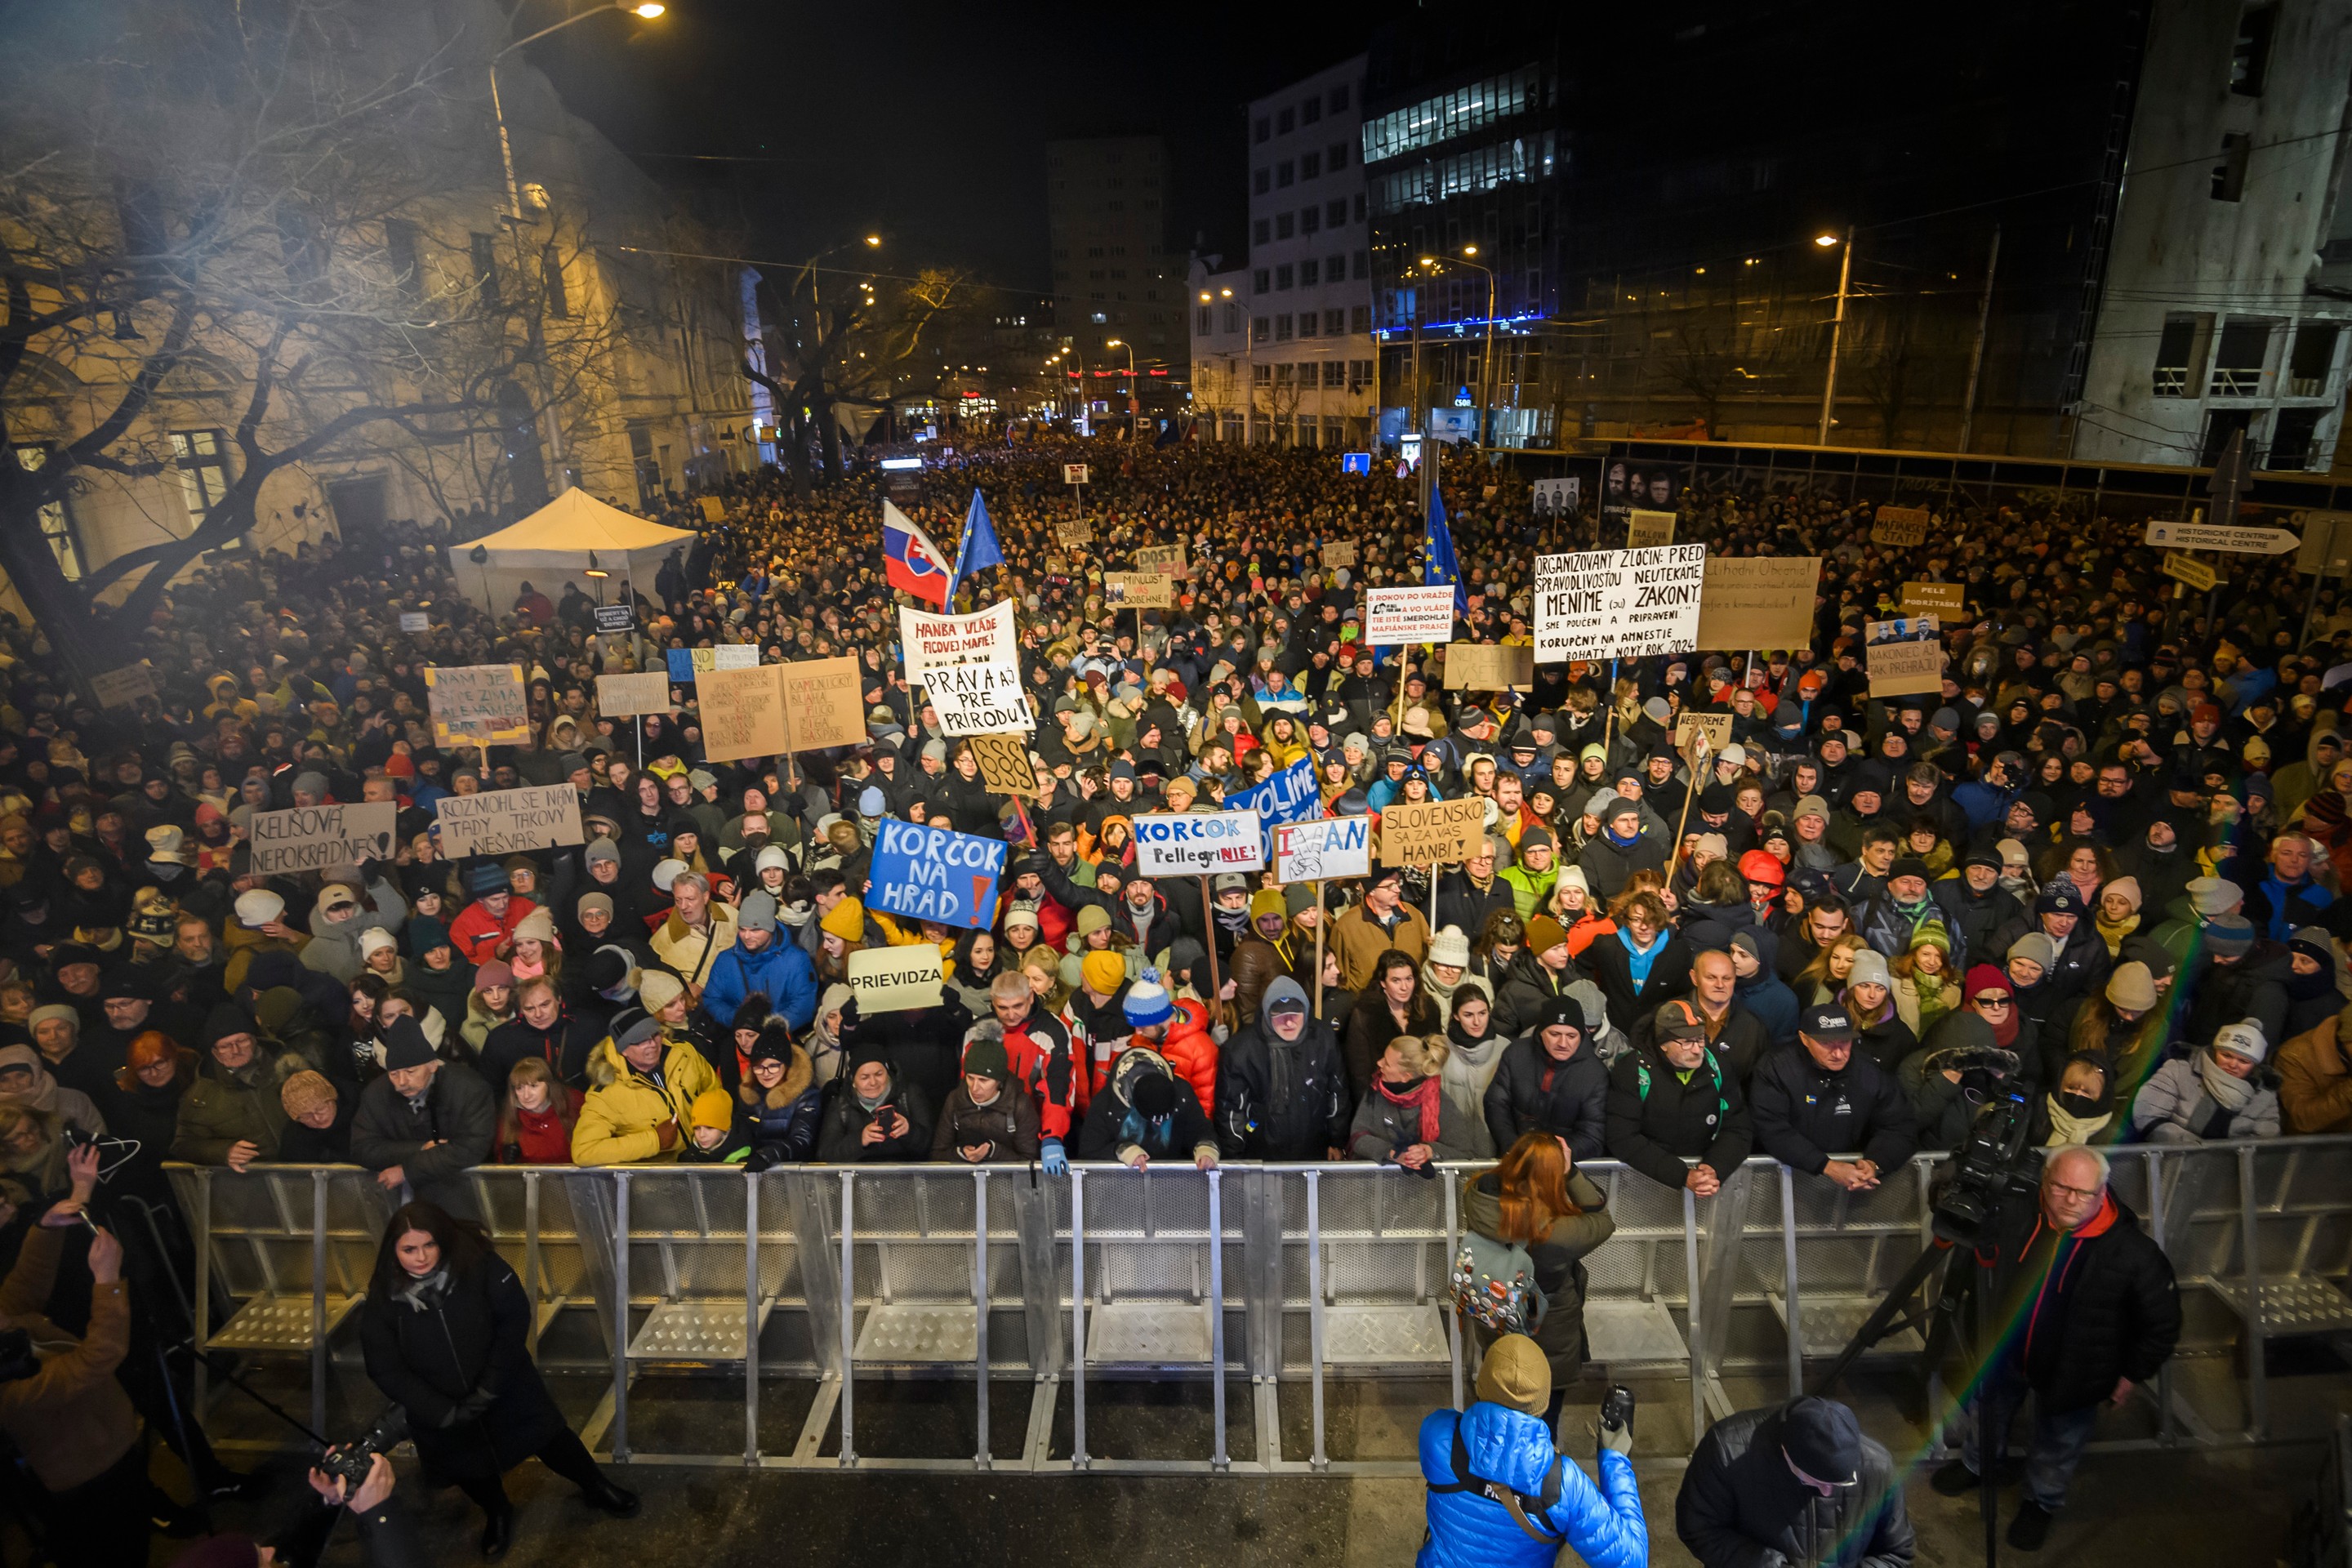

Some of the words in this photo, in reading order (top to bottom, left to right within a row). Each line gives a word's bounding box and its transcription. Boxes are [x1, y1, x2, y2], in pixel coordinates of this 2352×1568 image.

[2175, 536, 2229, 546] HISTORICAL
[2231, 539, 2269, 549] CENTRE
[2233, 531, 2280, 541] CENTRUM
[1536, 550, 1615, 576] ORGANIZOVANÝ
[1669, 546, 1704, 564] PRED
[1375, 593, 1405, 602] ROKOV
[1421, 590, 1454, 599] VRAŽDE
[1546, 589, 1604, 617] MENÍME
[1423, 604, 1450, 612] VLÁDE
[1385, 613, 1401, 622] ISTÉ
[1403, 613, 1450, 622] SMEROHLAS
[1610, 616, 1618, 624] A
[915, 622, 956, 639] HANBA
[1371, 623, 1418, 632] MAFIÁNSKE
[1419, 622, 1450, 630] PRASCE
[1540, 634, 1597, 648] KORUPČNÝ
[1601, 634, 1615, 644] NA
[1621, 628, 1673, 643] AMNESTIE
[924, 640, 960, 654] FICOVEJ
[1616, 643, 1643, 657] NOVÝ
[1646, 643, 1664, 655] ROK
[1668, 639, 1695, 653] 2024
[1869, 645, 1920, 661] NAKONIEC
[1922, 644, 1935, 656] AJ
[1869, 664, 1886, 675] TAK
[924, 666, 995, 694] PRÁVA
[1000, 666, 1015, 688] AJ
[791, 692, 827, 705] BLAHA
[957, 691, 995, 708] PRE
[806, 704, 834, 716] FICO
[1679, 715, 1726, 726] NEBDEME
[441, 795, 518, 819] ROZMOHL
[521, 791, 540, 808] SE
[546, 786, 575, 807] NÁM
[449, 817, 491, 838] TADY
[510, 807, 566, 831] TAKOVÝ
[1385, 800, 1483, 830] SLOVENSKO
[1135, 818, 1241, 844] KORČOK
[1394, 831, 1410, 844] SA
[1414, 829, 1430, 841] ZA
[1437, 825, 1462, 839] VÁS
[472, 830, 540, 854] NEŠVAR
[882, 823, 1004, 871] KORČOK
[908, 859, 947, 889] NA
[882, 882, 960, 920] HRAD
[850, 968, 942, 990] PRIEVIDZA
